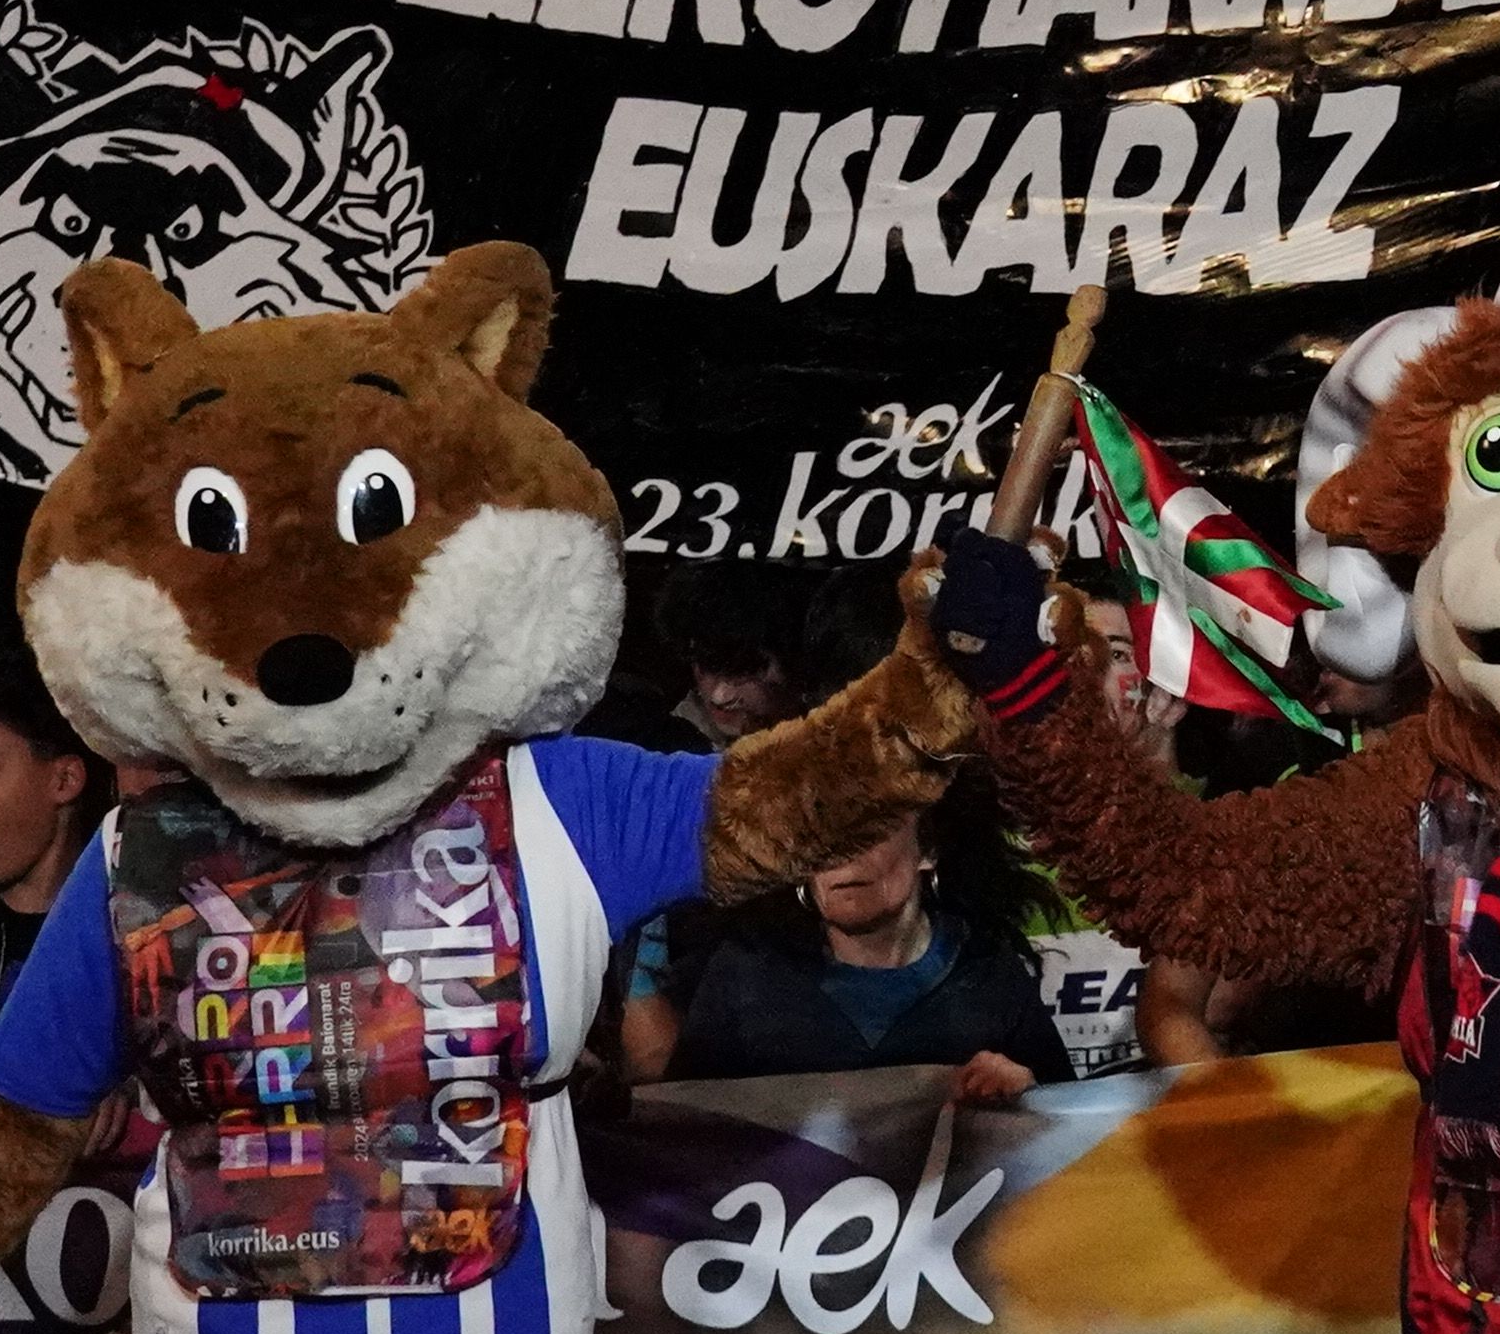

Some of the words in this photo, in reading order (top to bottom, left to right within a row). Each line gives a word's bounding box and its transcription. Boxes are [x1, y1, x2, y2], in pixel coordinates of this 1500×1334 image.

[565, 85, 1402, 303] EUSKARAZ
[836, 369, 1016, 481] aek
[382, 820, 503, 1186] korrika
[207, 1229, 341, 1258] korrika.eus
